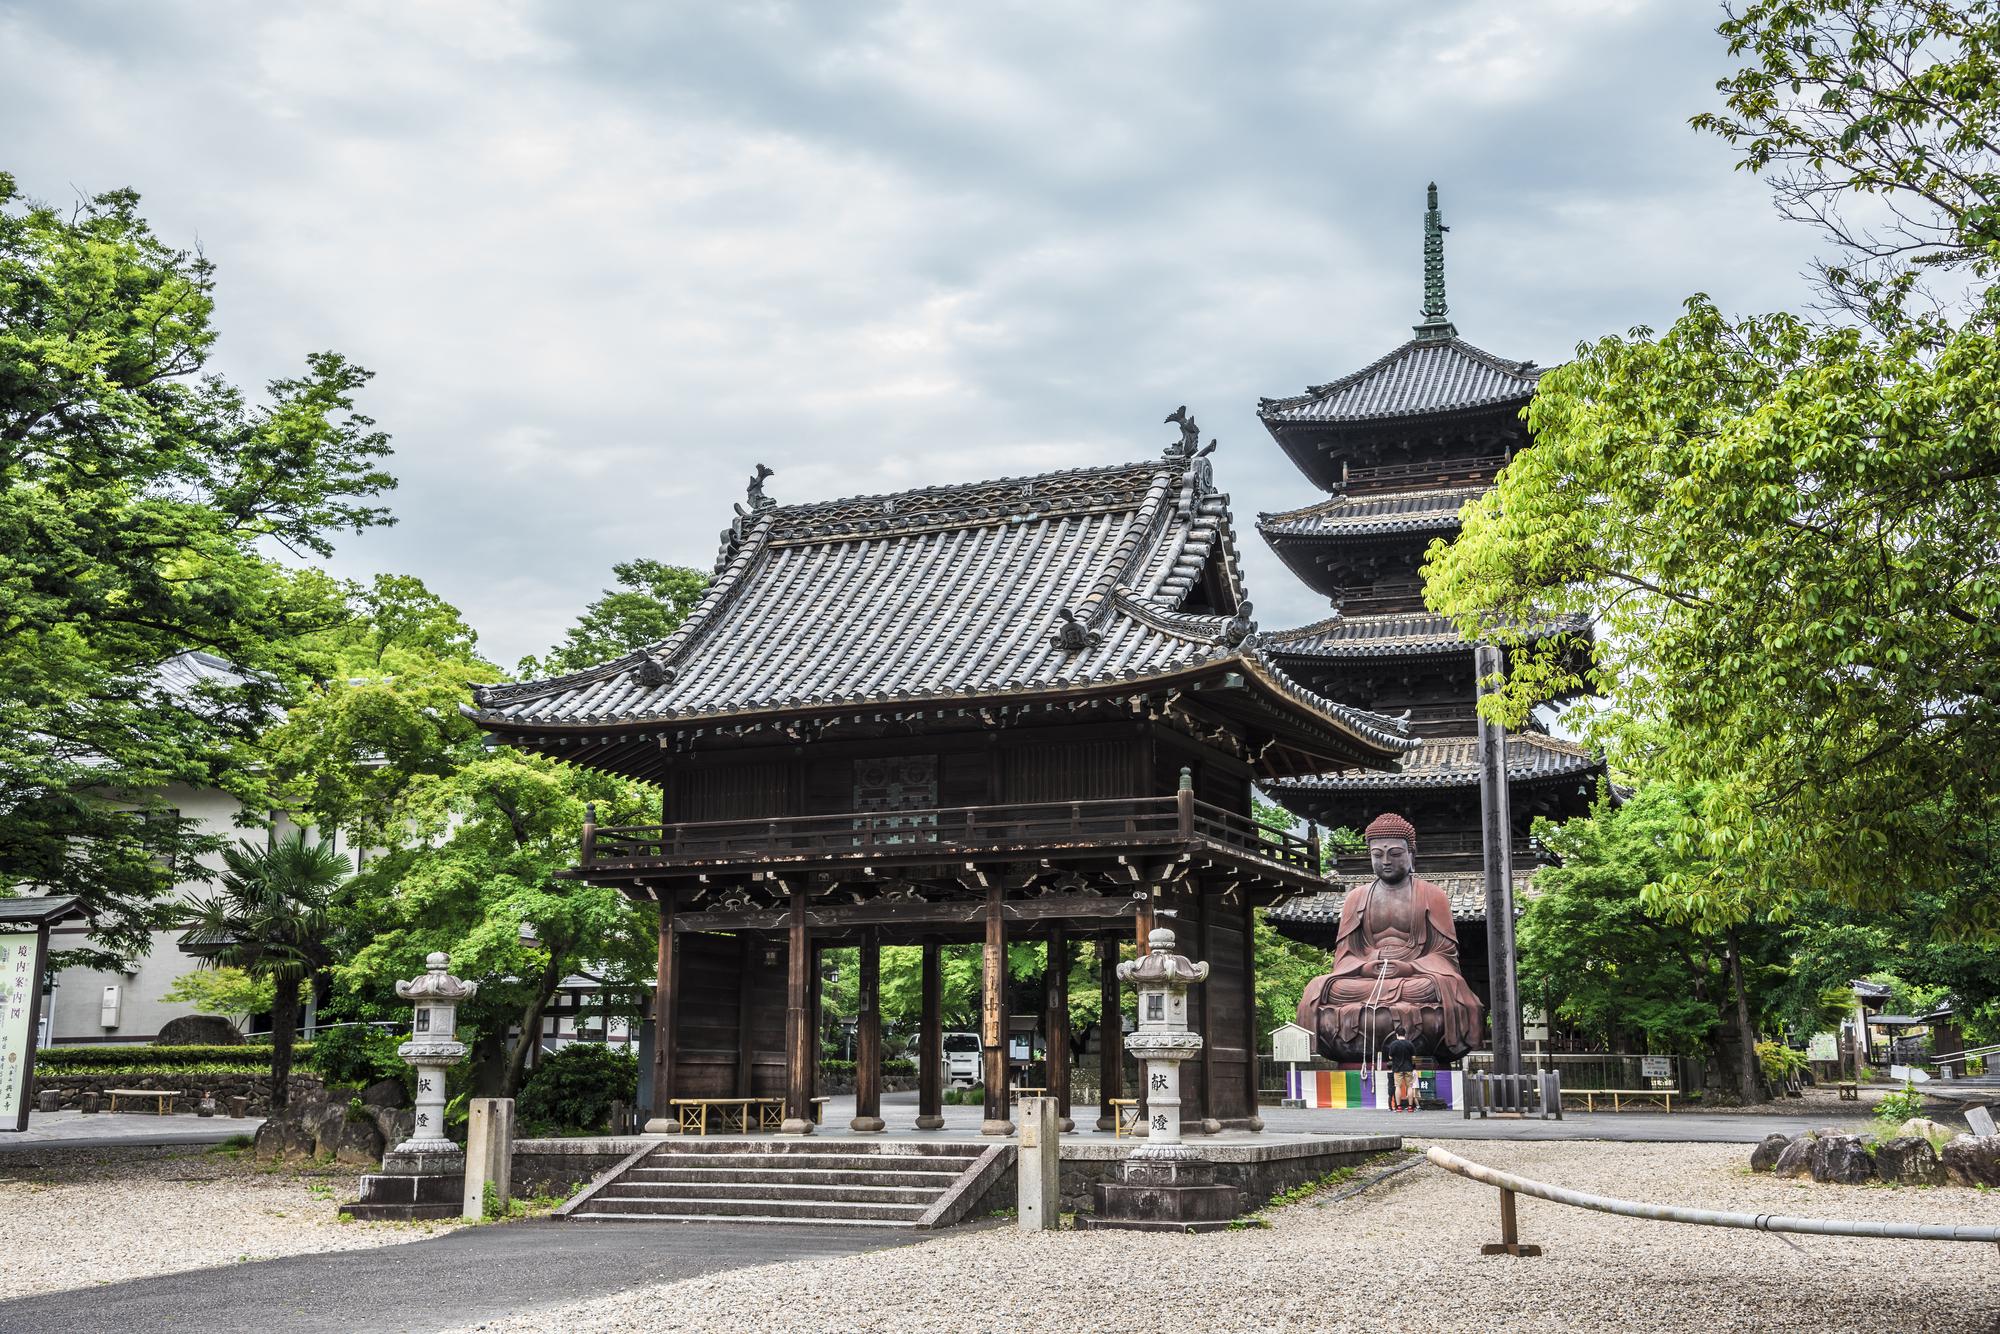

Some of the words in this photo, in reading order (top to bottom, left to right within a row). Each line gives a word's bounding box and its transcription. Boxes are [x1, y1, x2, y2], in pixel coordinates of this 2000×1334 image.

[11, 945, 28, 1019] 境内案内図
